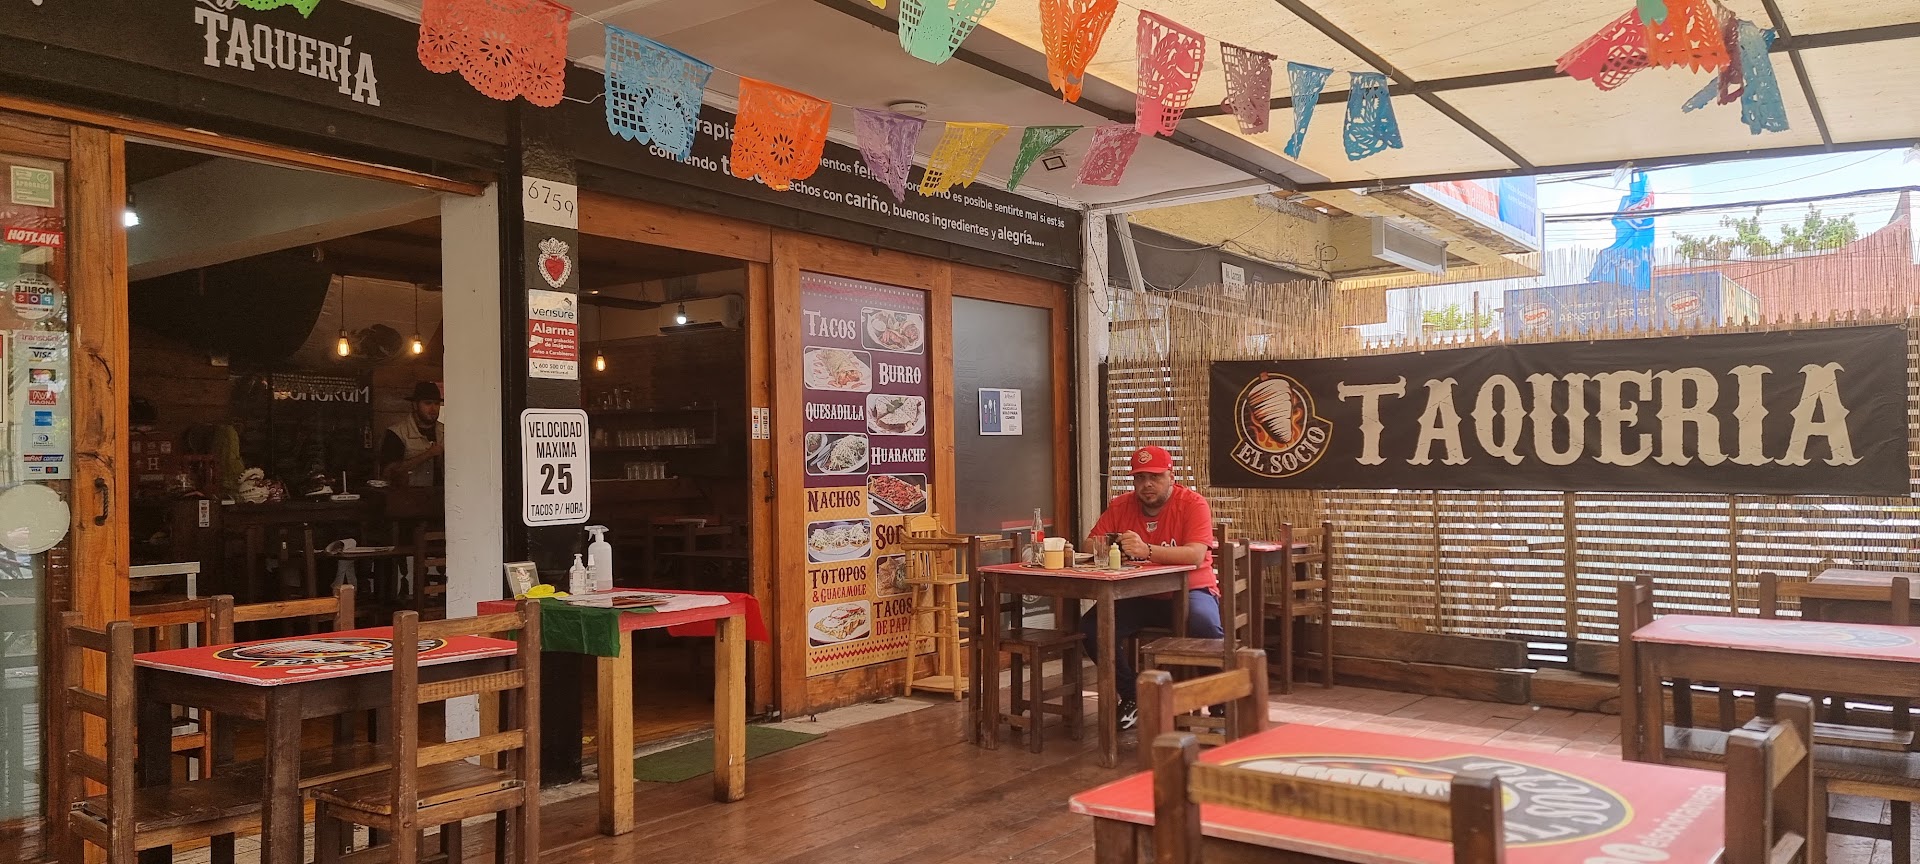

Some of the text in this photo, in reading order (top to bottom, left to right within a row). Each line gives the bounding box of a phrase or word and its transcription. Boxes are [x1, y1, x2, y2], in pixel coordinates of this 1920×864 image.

[195, 7, 380, 106] TAQUERÍA
[528, 181, 574, 218] 6759
[649, 144, 718, 172] comendo
[789, 181, 821, 198] echos
[823, 189, 843, 203] con
[845, 192, 891, 216] cariño,
[893, 203, 930, 224] buenos
[932, 212, 989, 237] ingredientes
[991, 230, 997, 240] y
[953, 193, 963, 203] es
[964, 196, 993, 210] posible
[995, 203, 1024, 218] sentirte
[1025, 209, 1039, 222] mal
[1040, 213, 1046, 223] si
[1046, 216, 1065, 228] estás
[532, 307, 574, 319] verisure
[803, 309, 857, 340] TACOS
[532, 322, 575, 336] Alarma
[878, 362, 922, 386] BURRO
[805, 401, 865, 422] QUESADILLA
[1337, 361, 1864, 467] TAQUERIA
[528, 421, 582, 438] VELOCIDAD
[536, 441, 577, 458] MAXIMA
[870, 447, 926, 466] HUARACHE
[1236, 426, 1326, 474] EL SOCIO
[540, 463, 573, 495] 25
[531, 503, 554, 516] TACOS
[565, 502, 583, 515] HORA
[807, 490, 861, 513] NACHOS
[808, 565, 867, 590] TOTOPOS
[812, 583, 867, 603] & GUACAMOLE
[873, 597, 913, 619] TACOS
[876, 619, 887, 636] DE
